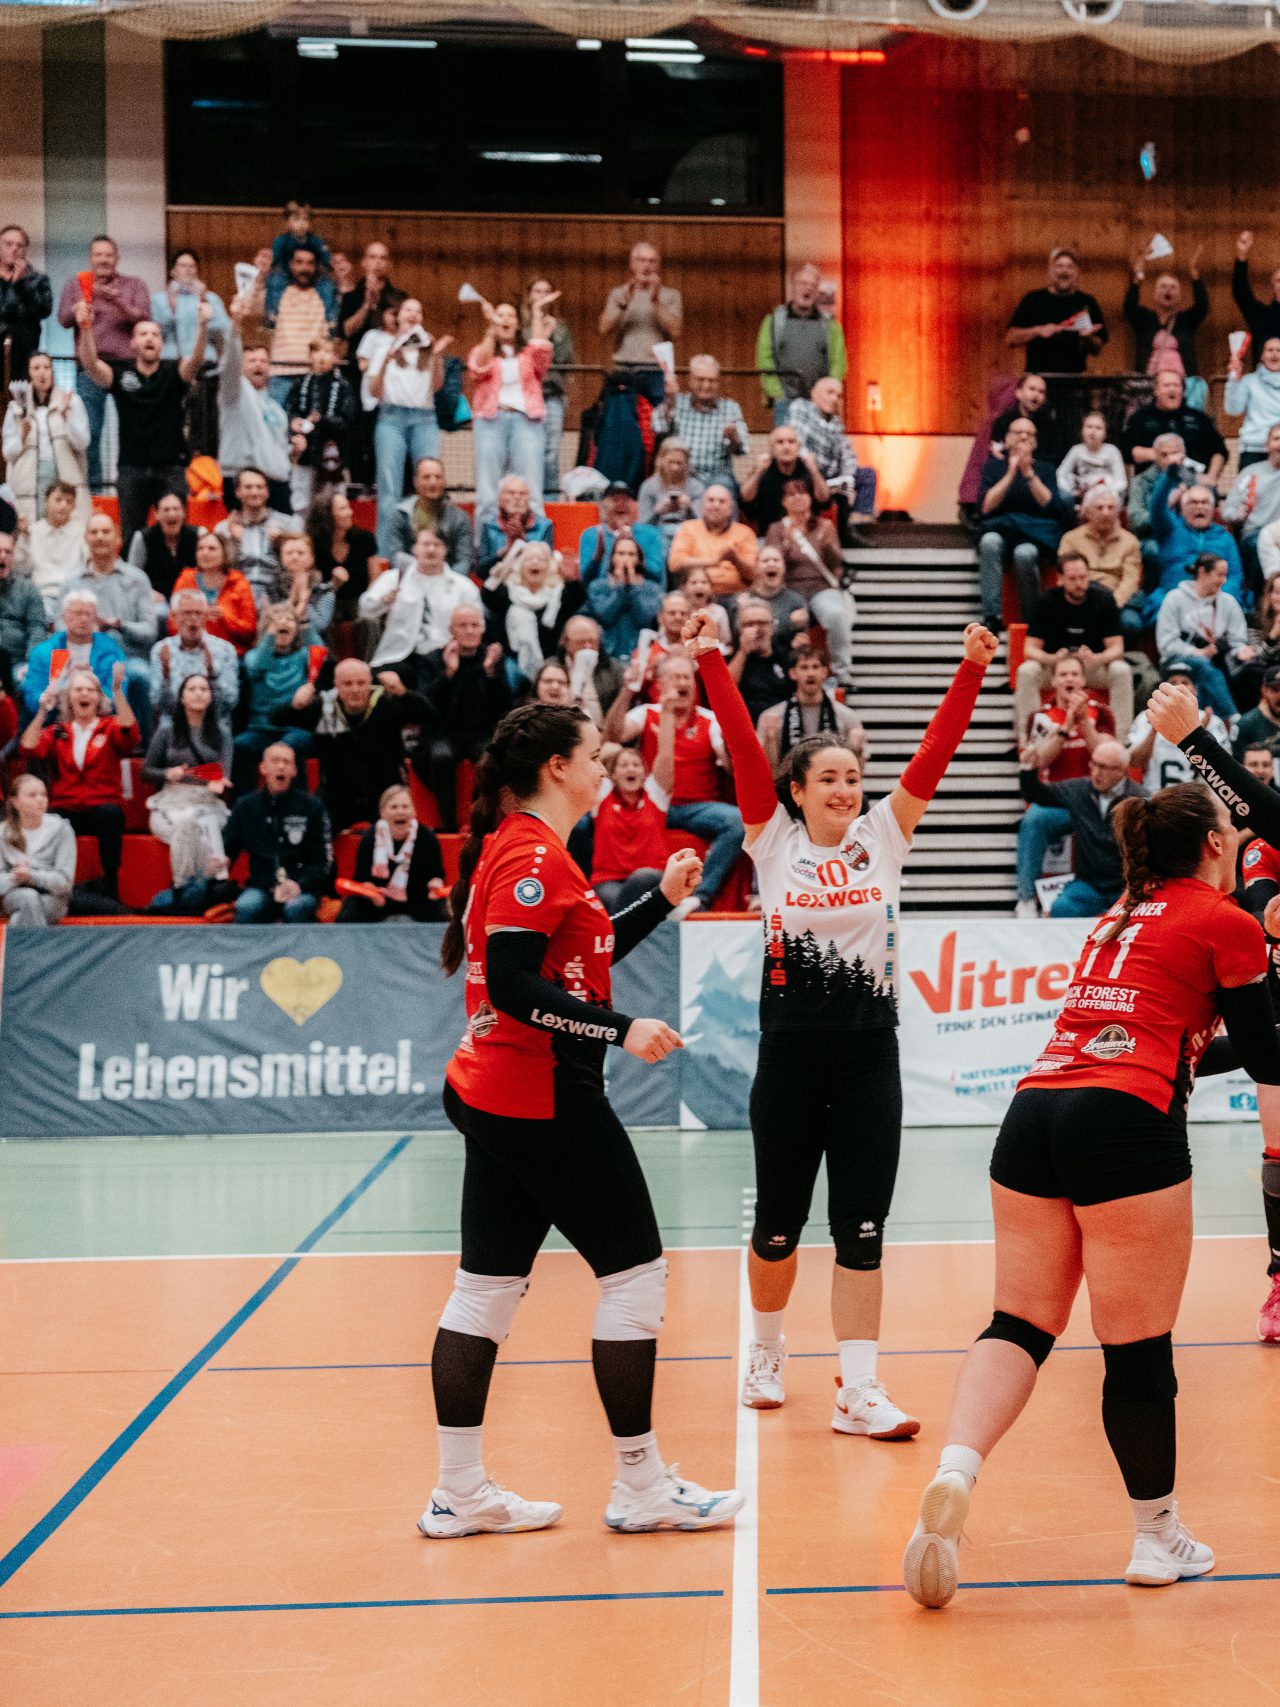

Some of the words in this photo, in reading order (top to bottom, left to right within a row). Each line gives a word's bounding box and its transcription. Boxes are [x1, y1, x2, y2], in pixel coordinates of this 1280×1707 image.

[1184, 744, 1250, 817] Lexware
[816, 859, 849, 888] 10
[786, 886, 882, 908] Lexware
[1081, 921, 1143, 979] 11
[908, 930, 1078, 1014] Vitre
[158, 963, 249, 1022] Wir
[1077, 998, 1135, 1013] OFFENBURG
[1083, 985, 1140, 1003] FOREST
[530, 1008, 618, 1042] Lexware
[1012, 1008, 1060, 1025] SCHWAR
[1081, 1036, 1137, 1054] Brauwerk
[78, 1039, 426, 1101] Lebensmittel.
